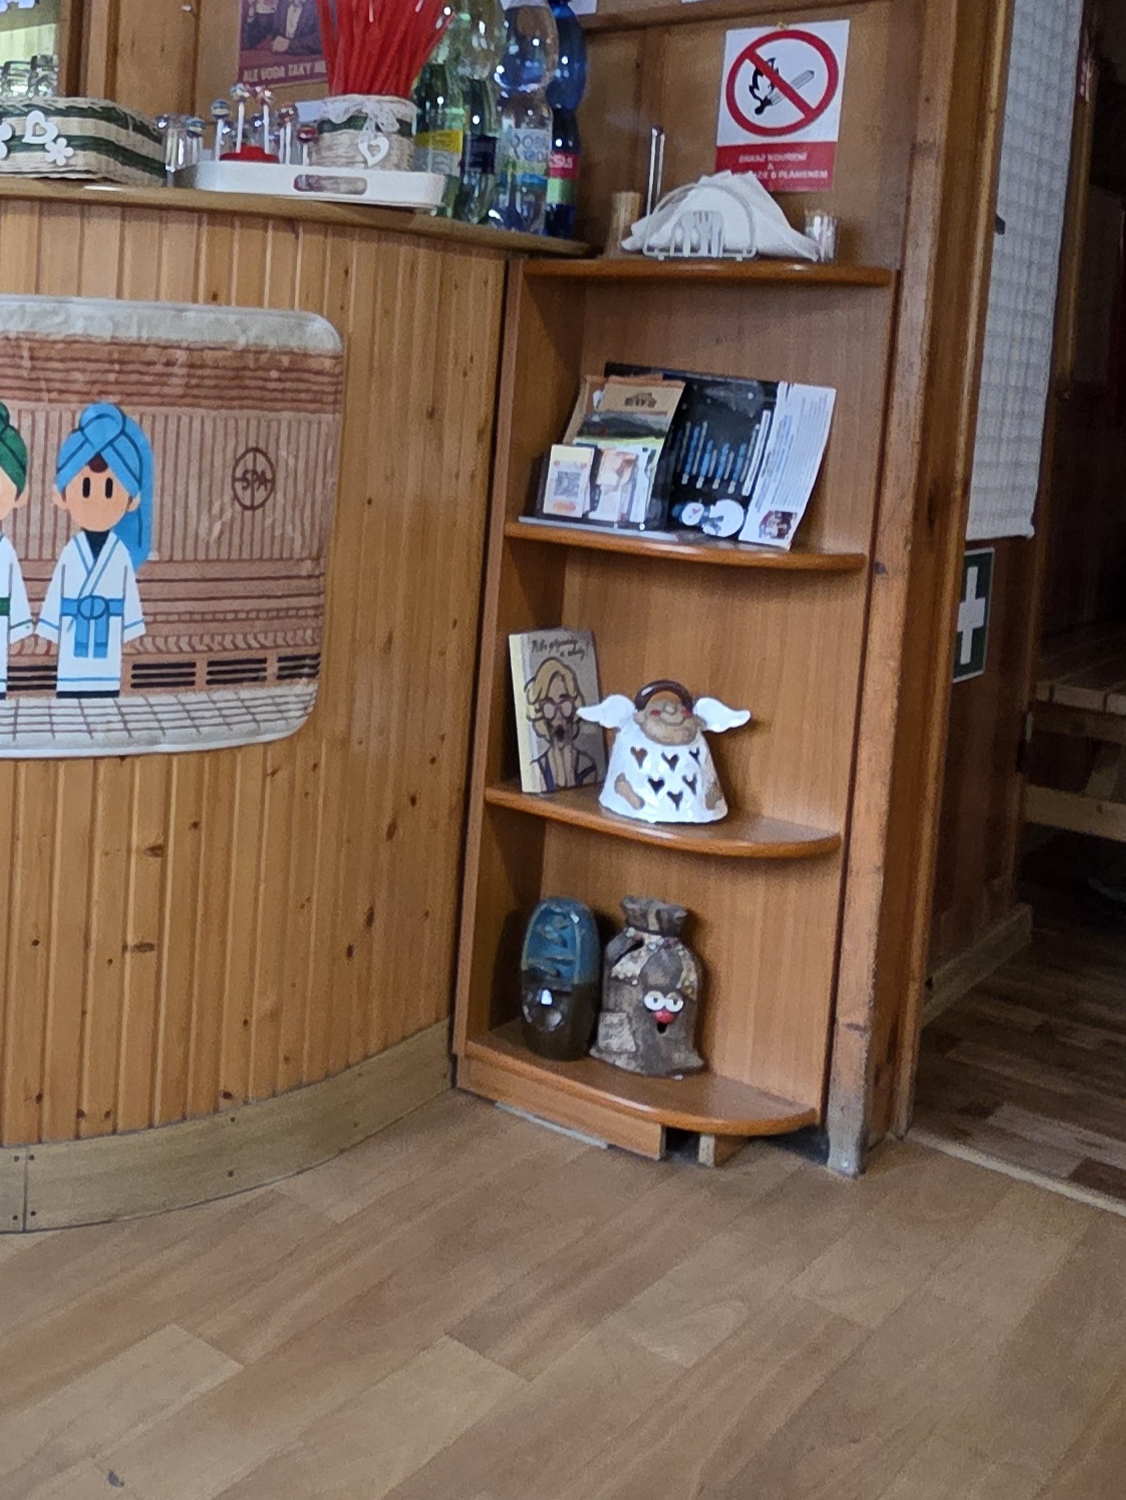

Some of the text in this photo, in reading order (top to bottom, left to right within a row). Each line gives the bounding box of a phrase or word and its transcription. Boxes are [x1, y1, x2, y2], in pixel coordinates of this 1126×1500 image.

[243, 68, 258, 82] ALE
[260, 66, 285, 81] VODA
[288, 62, 313, 78] TAKY
[767, 162, 774, 170] A
[241, 469, 269, 492] SPA
